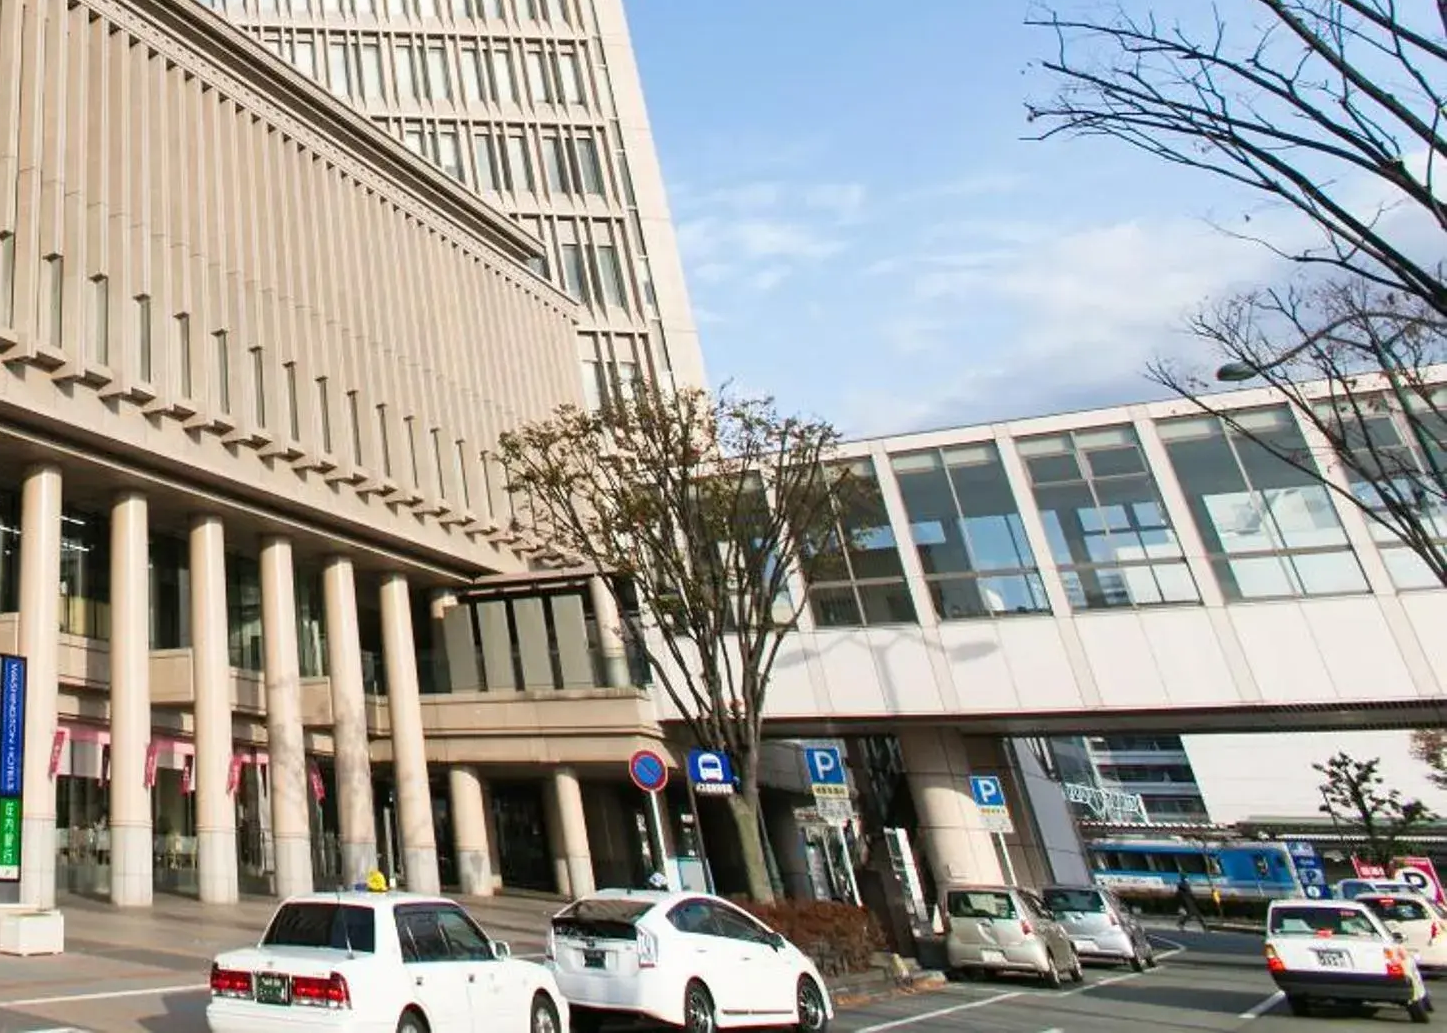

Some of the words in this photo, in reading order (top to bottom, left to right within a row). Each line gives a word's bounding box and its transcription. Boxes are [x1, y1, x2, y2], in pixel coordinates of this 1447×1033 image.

[8, 663, 18, 743] WASHINGTON
[813, 750, 835, 781] P
[978, 779, 996, 803] P
